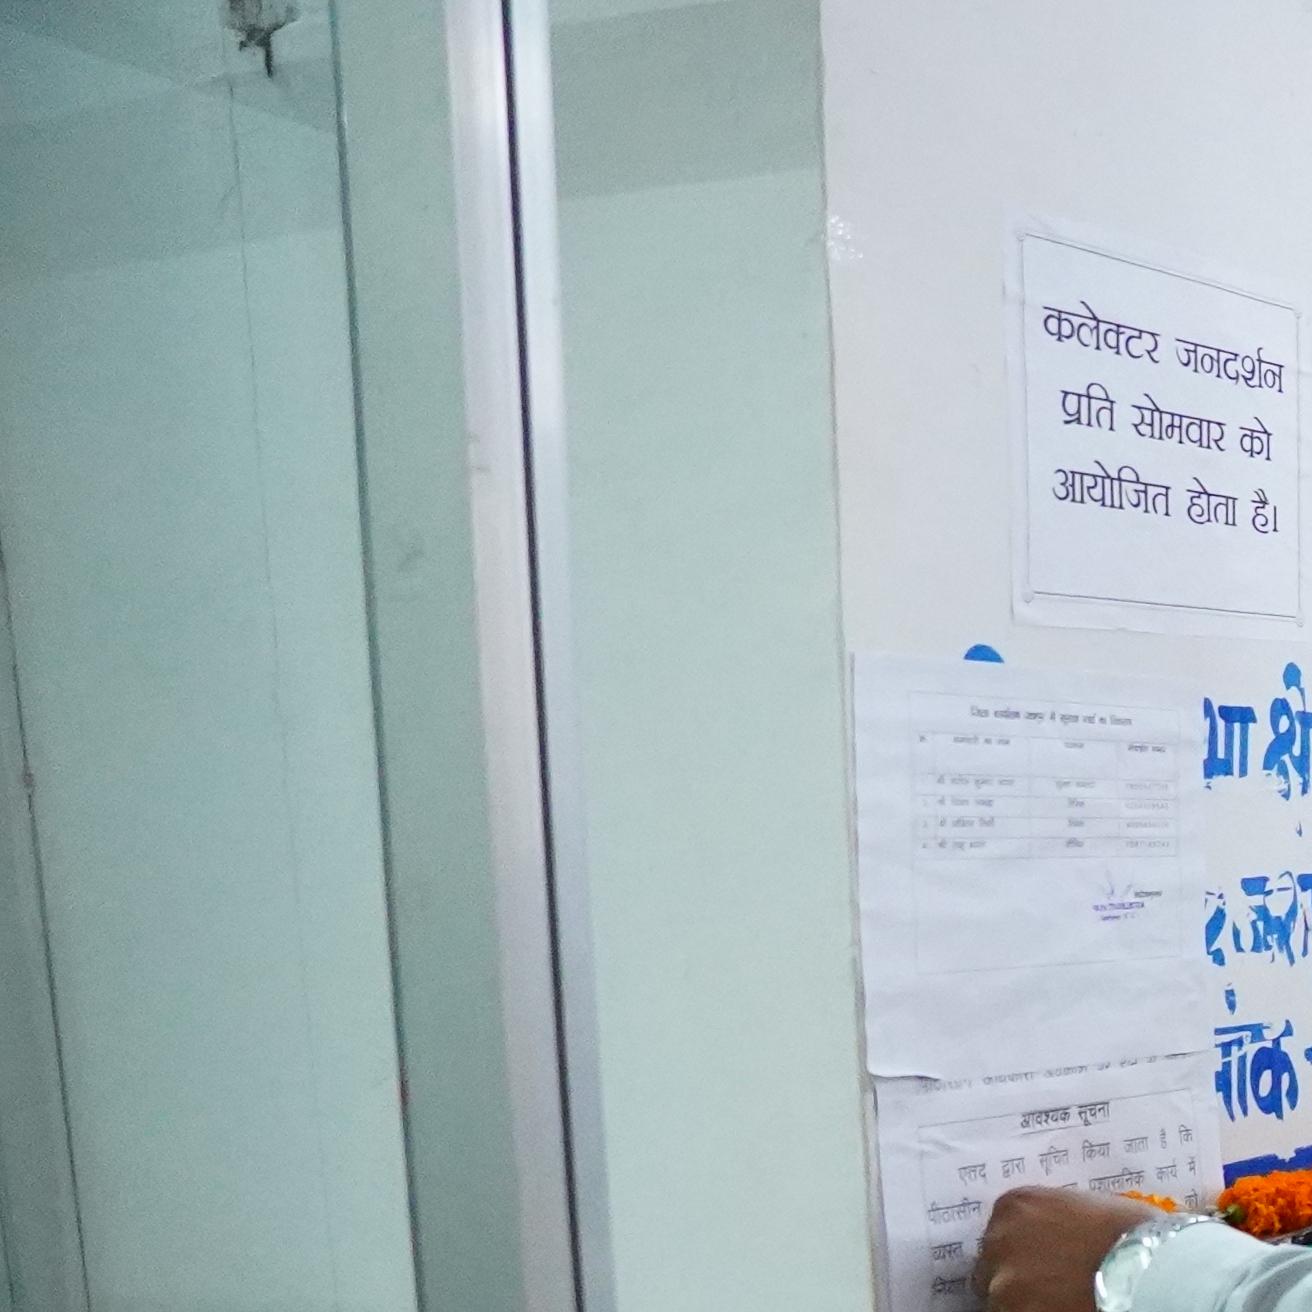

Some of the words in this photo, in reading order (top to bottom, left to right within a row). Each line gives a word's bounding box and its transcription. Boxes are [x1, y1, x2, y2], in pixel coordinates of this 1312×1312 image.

[1043, 302, 1159, 363] कलेक्टर
[1176, 338, 1284, 393] जनदर्शन
[1061, 383, 1115, 432] प्रति
[1132, 395, 1225, 452] सोमवार
[1240, 418, 1271, 461] को
[1053, 462, 1170, 516] आयोजित
[1187, 478, 1236, 527] होता
[1020, 1103, 1070, 1129] आवश्यक
[1078, 1101, 1110, 1127] सूचना
[1002, 1157, 1025, 1179] द्वारा
[1039, 1146, 1069, 1177] सूचित
[1082, 1140, 1110, 1162] किया
[1124, 1135, 1148, 1154] जाता
[1178, 1124, 1193, 1145] कि
[1156, 1162, 1178, 1183] कार्य
